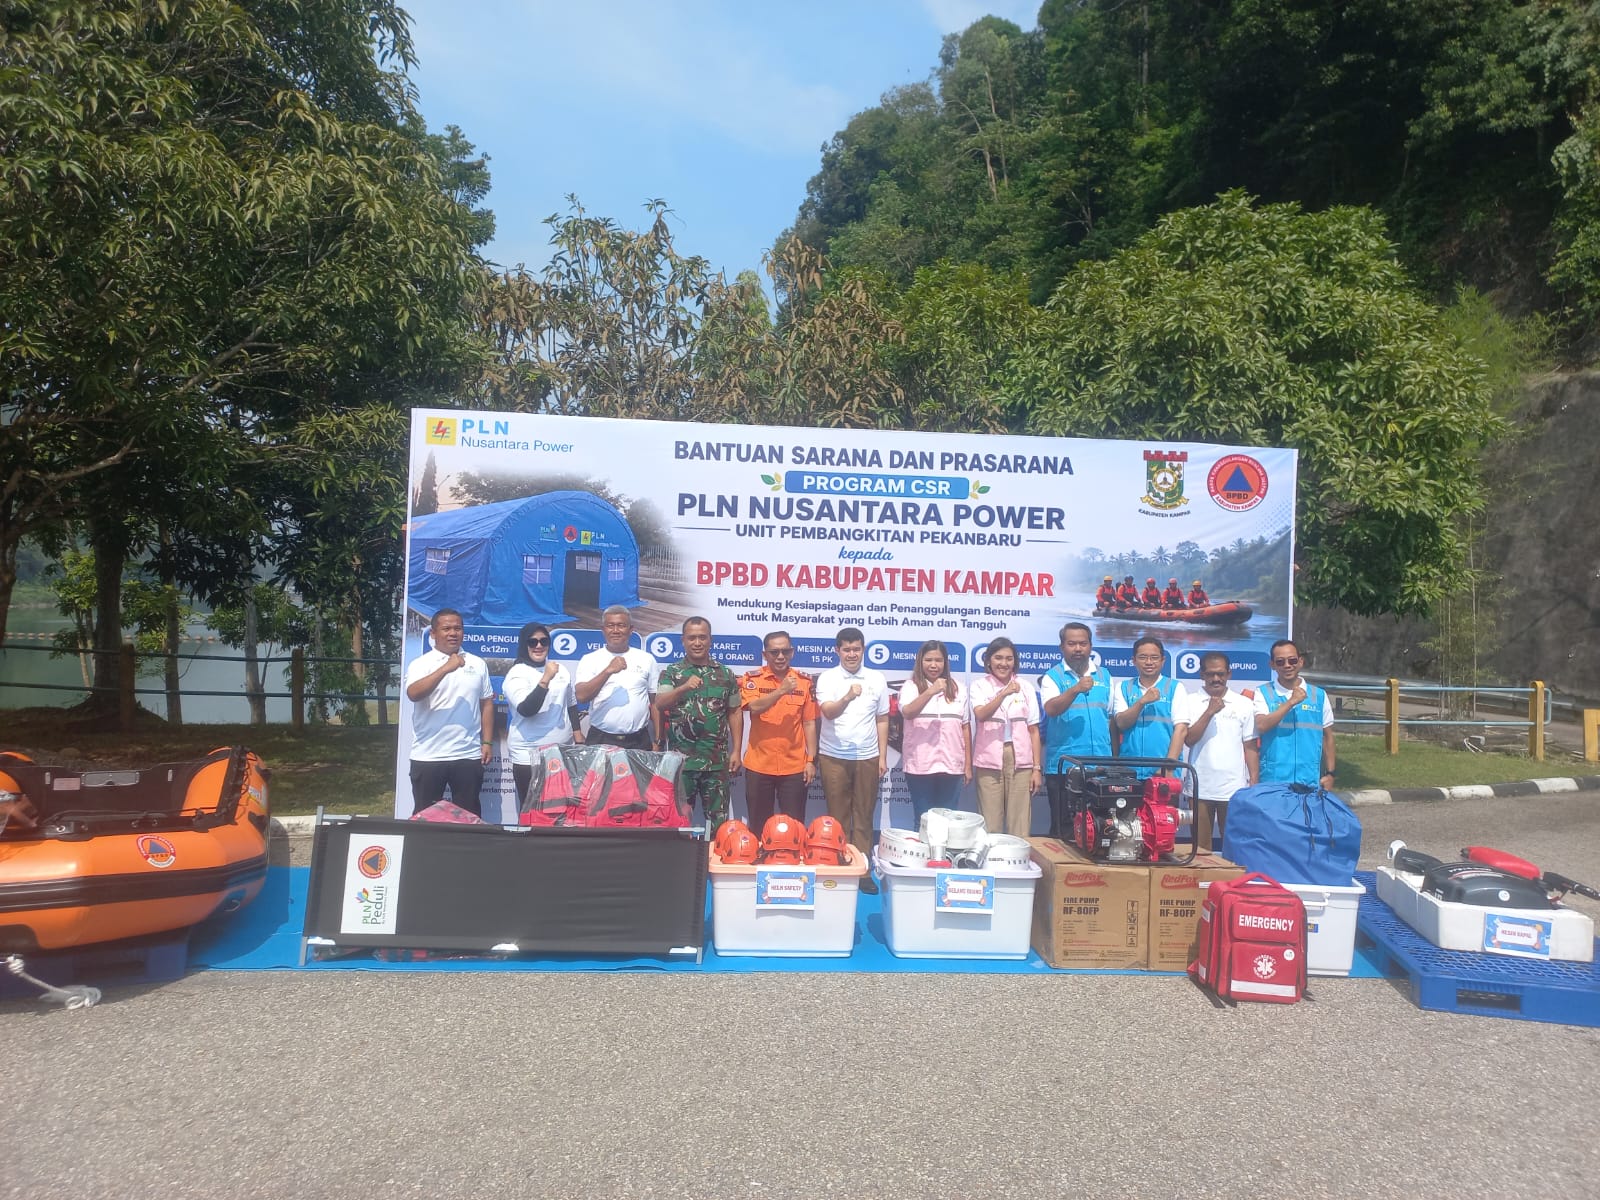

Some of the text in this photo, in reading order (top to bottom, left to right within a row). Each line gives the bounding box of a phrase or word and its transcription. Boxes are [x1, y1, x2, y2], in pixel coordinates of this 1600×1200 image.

[462, 418, 509, 435] PLN
[461, 436, 574, 453] Nusantara Power
[674, 440, 1074, 475] BANTUAN SARANA DAN PRASARANA
[803, 475, 950, 496] PROGRAM CSR
[1226, 492, 1249, 500] BPBD
[677, 493, 1065, 530] PLN NUSANTARA POWER
[735, 524, 1022, 547] UNIT PEMBANGKITAN PEKANBARU
[838, 545, 894, 563] kepada
[696, 561, 1054, 597] BPBD KABUPATEN KAMPAR
[717, 597, 1031, 617] Mendukung Kesiapsiagaan dan Penanggulangan Bencana
[737, 613, 1007, 631] untuk Masyarakat yang Lebih Aman dan Tangguh
[463, 633, 486, 642] ENDA
[559, 637, 570, 651] 2
[480, 644, 509, 653] 6x12m
[657, 641, 667, 653] 3
[713, 642, 741, 651] KARET
[797, 645, 823, 653] MESIN
[725, 653, 755, 661] ORANG
[811, 655, 833, 663] 15 PK
[874, 648, 884, 660] 5
[892, 652, 917, 660] MESIN
[1033, 652, 1062, 660] BUANG
[1104, 658, 1127, 667] HELM
[1185, 657, 1196, 669] 8
[1229, 662, 1258, 671] MPUNG
[370, 885, 385, 925] Peduli
[362, 905, 372, 924] PLN
[1238, 914, 1294, 932] EMERGENCY
